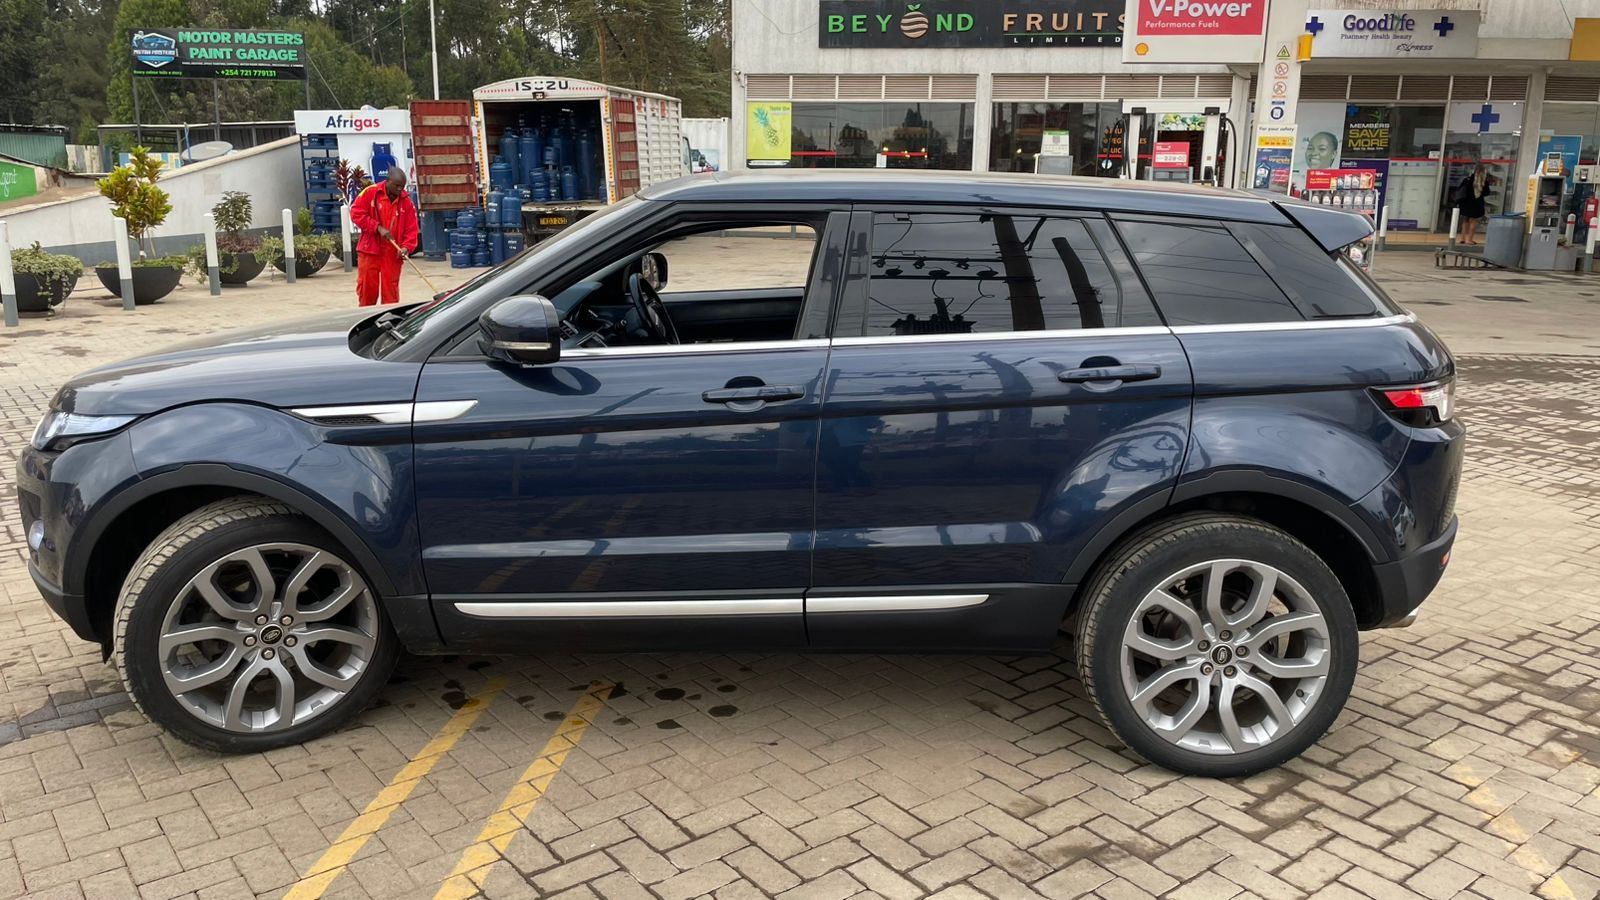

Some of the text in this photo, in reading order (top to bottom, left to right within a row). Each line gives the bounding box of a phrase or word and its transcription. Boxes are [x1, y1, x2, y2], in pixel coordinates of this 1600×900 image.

[1149, 0, 1252, 17] V-Power
[1145, 20, 1219, 28] Performance Fuels
[178, 31, 304, 45] MOTOR MASTERS
[189, 47, 298, 61] PAINT GARAGE
[326, 114, 380, 131] Afrigas
[1348, 129, 1389, 138] SAVE
[1347, 138, 1389, 148] MORE
[0, 168, 17, 197] gent
